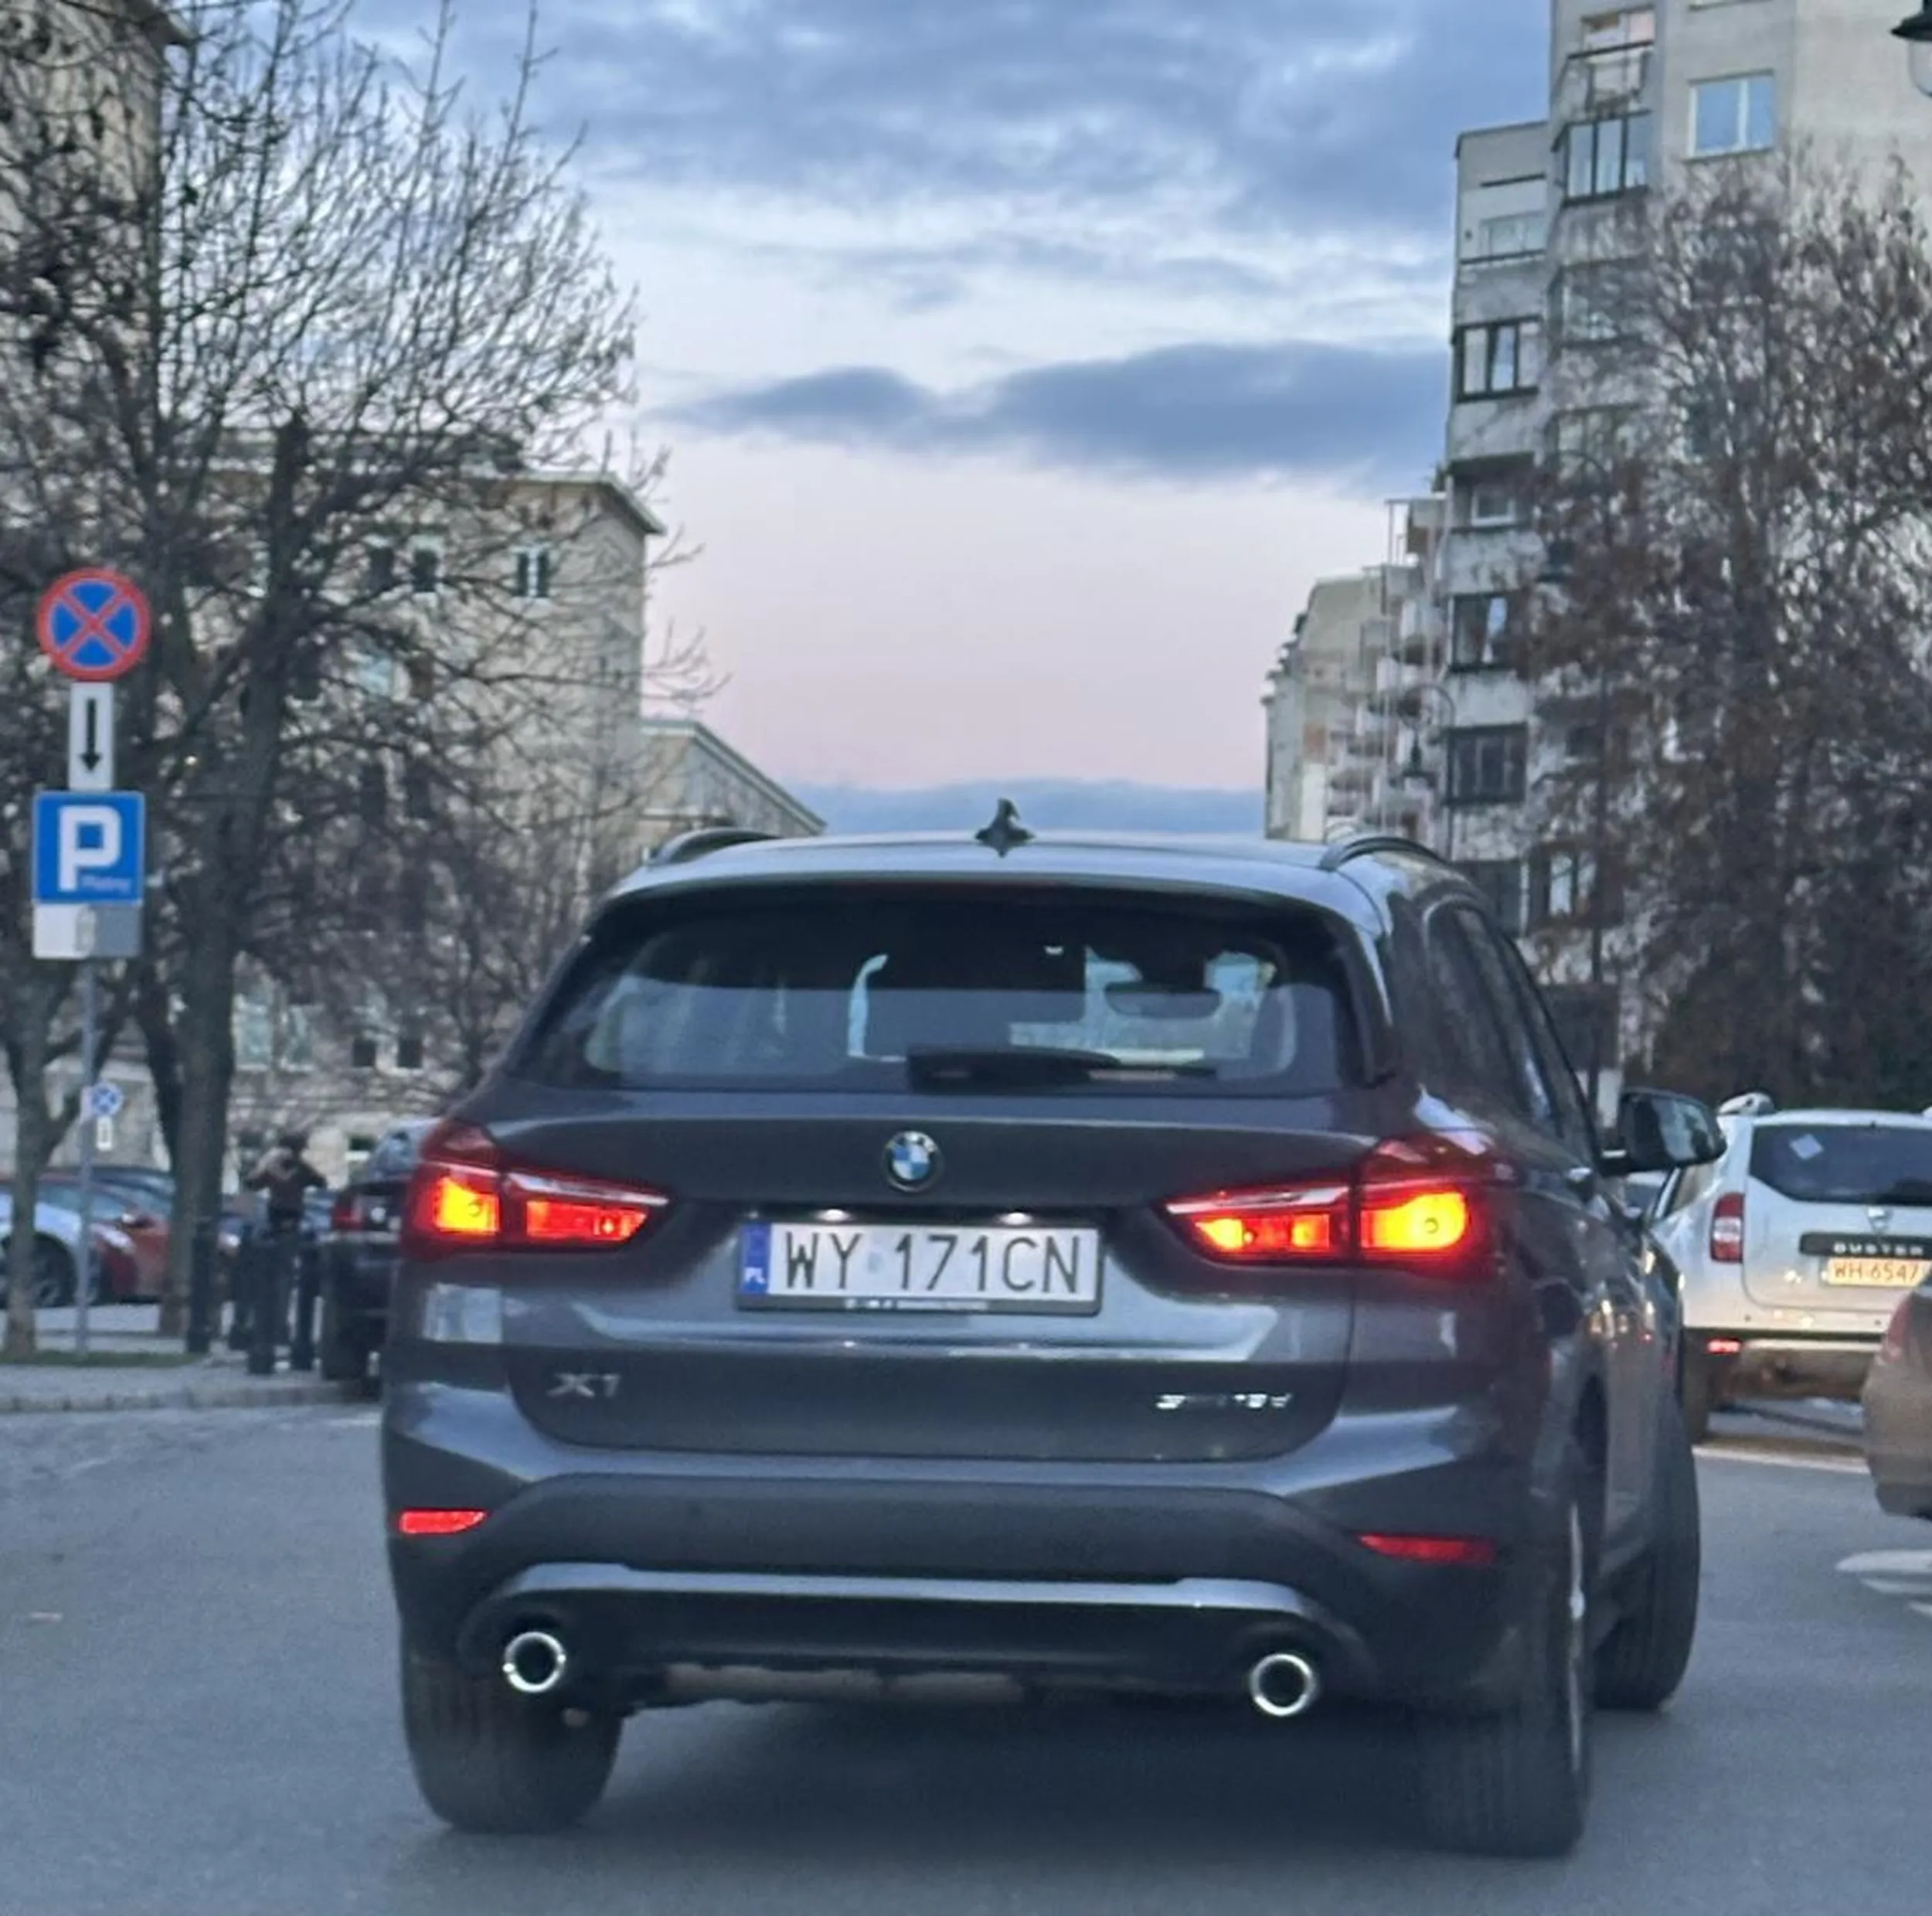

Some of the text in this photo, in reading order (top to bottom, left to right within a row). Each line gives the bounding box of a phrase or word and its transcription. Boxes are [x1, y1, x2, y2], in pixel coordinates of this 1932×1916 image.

[59, 805, 121, 892] P
[785, 1231, 1080, 1294] WY 171CN
[1835, 1261, 1862, 1279] WH
[546, 1373, 621, 1397] X1
